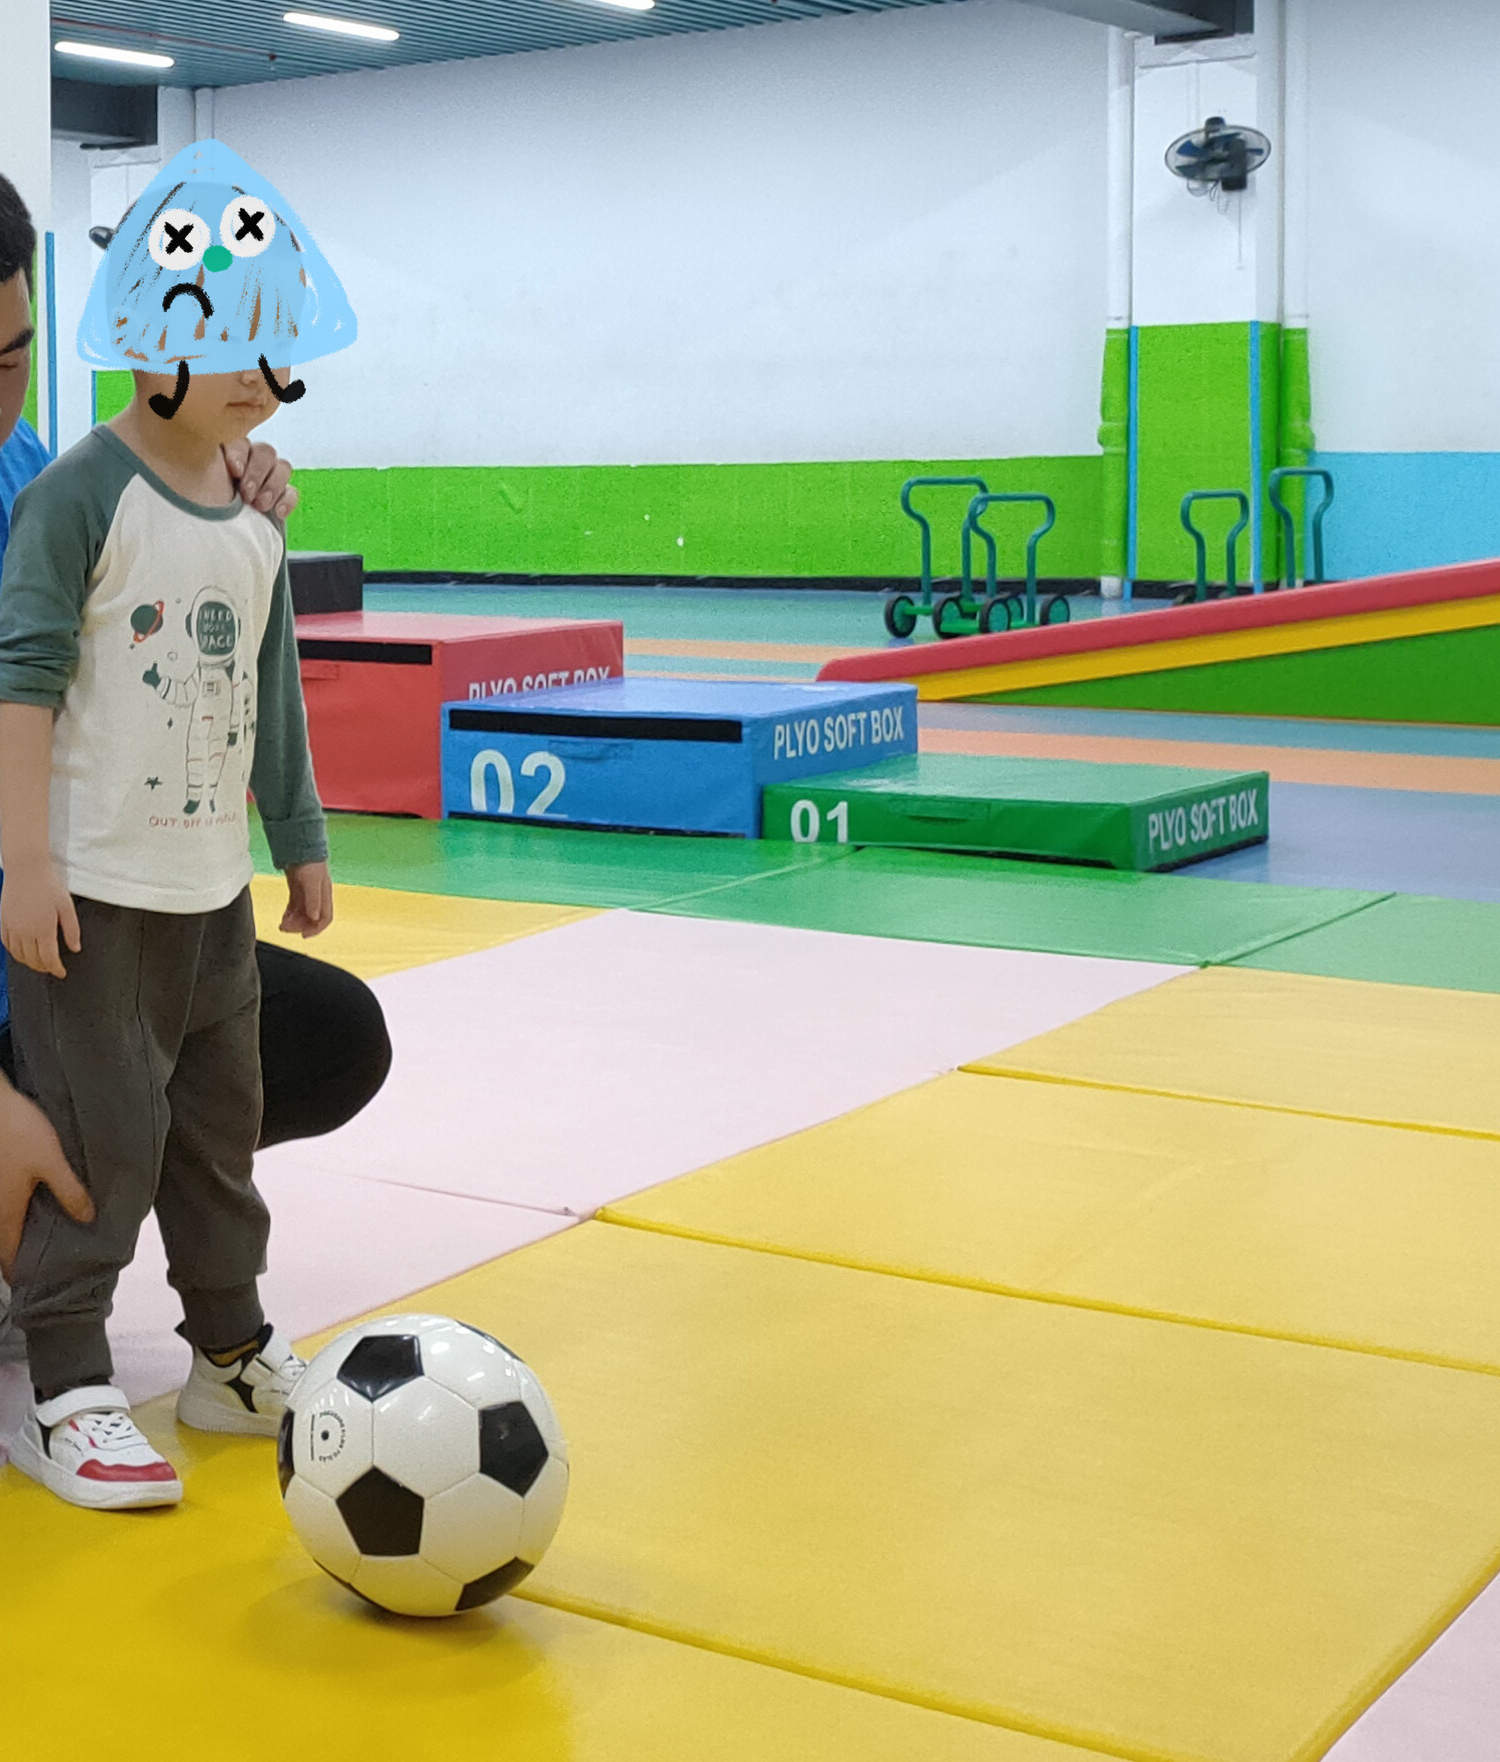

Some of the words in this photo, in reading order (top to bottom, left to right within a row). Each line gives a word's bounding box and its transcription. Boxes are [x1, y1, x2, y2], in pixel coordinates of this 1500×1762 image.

[774, 718, 820, 760] PLYO
[823, 711, 867, 752] SOFT
[870, 706, 904, 744] BOX
[470, 749, 568, 818] 02
[149, 815, 177, 828] OUT
[790, 799, 848, 843] 01
[1148, 806, 1187, 855] PLYO
[1190, 798, 1226, 843] SOFT
[1229, 789, 1258, 832] BOX
